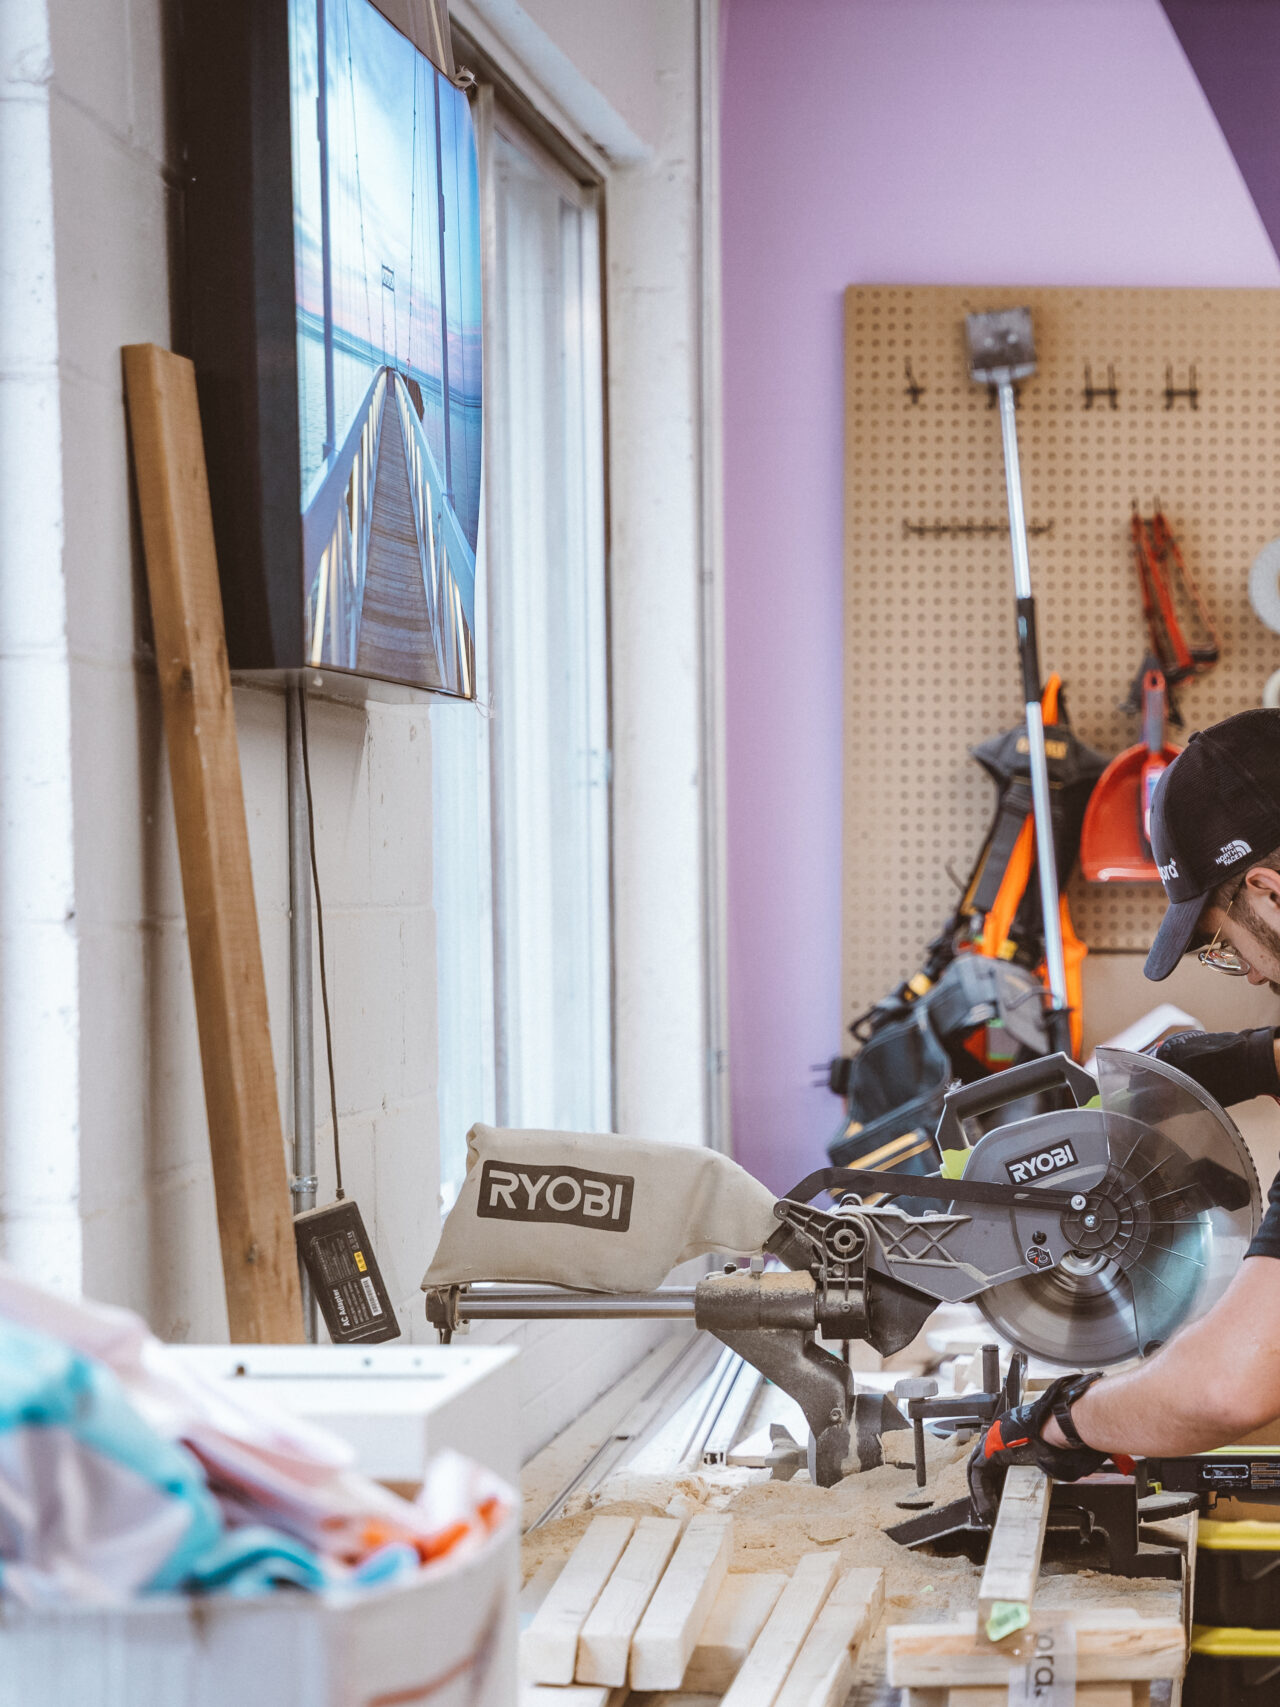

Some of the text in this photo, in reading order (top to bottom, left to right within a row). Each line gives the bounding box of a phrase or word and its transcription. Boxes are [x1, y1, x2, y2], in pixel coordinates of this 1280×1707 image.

[1215, 849, 1239, 865] NORTH
[1220, 842, 1234, 854] THE
[1223, 853, 1241, 867] FACE
[1008, 1144, 1075, 1184] RYOBI
[488, 1169, 624, 1220] RYOBI
[332, 1289, 351, 1327] AC Adapter
